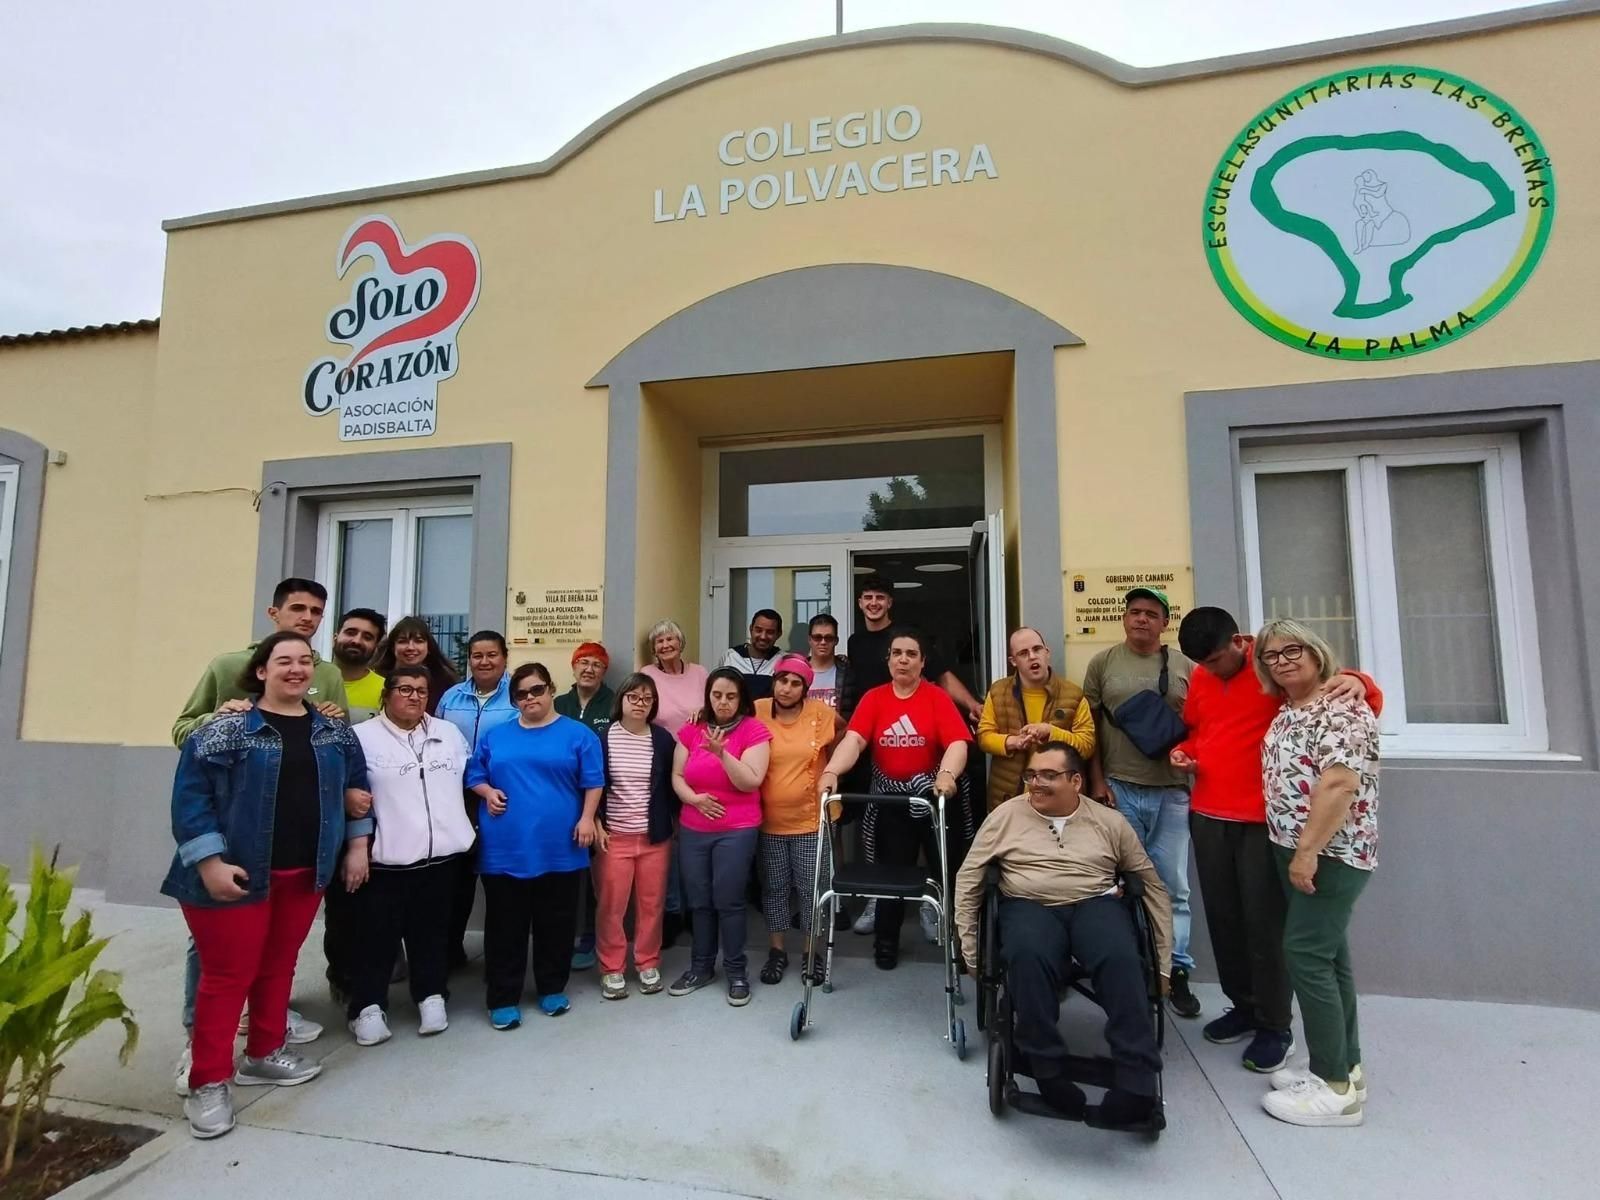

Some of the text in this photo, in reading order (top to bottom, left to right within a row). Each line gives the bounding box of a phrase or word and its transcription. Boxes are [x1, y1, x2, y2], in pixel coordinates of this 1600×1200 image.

[718, 104, 922, 166] COLEGIO
[1432, 78, 1487, 111] LAS
[1492, 112, 1552, 210] BREÑAS
[654, 143, 999, 223] LA POLVACERA
[1305, 310, 1476, 356] LA PALMA
[343, 397, 434, 418] ASOCIACIÓN
[343, 419, 433, 437] PADISBALTA
[1105, 573, 1175, 583] GOBIERNO DE CANARIAS
[879, 735, 926, 748] adidas
